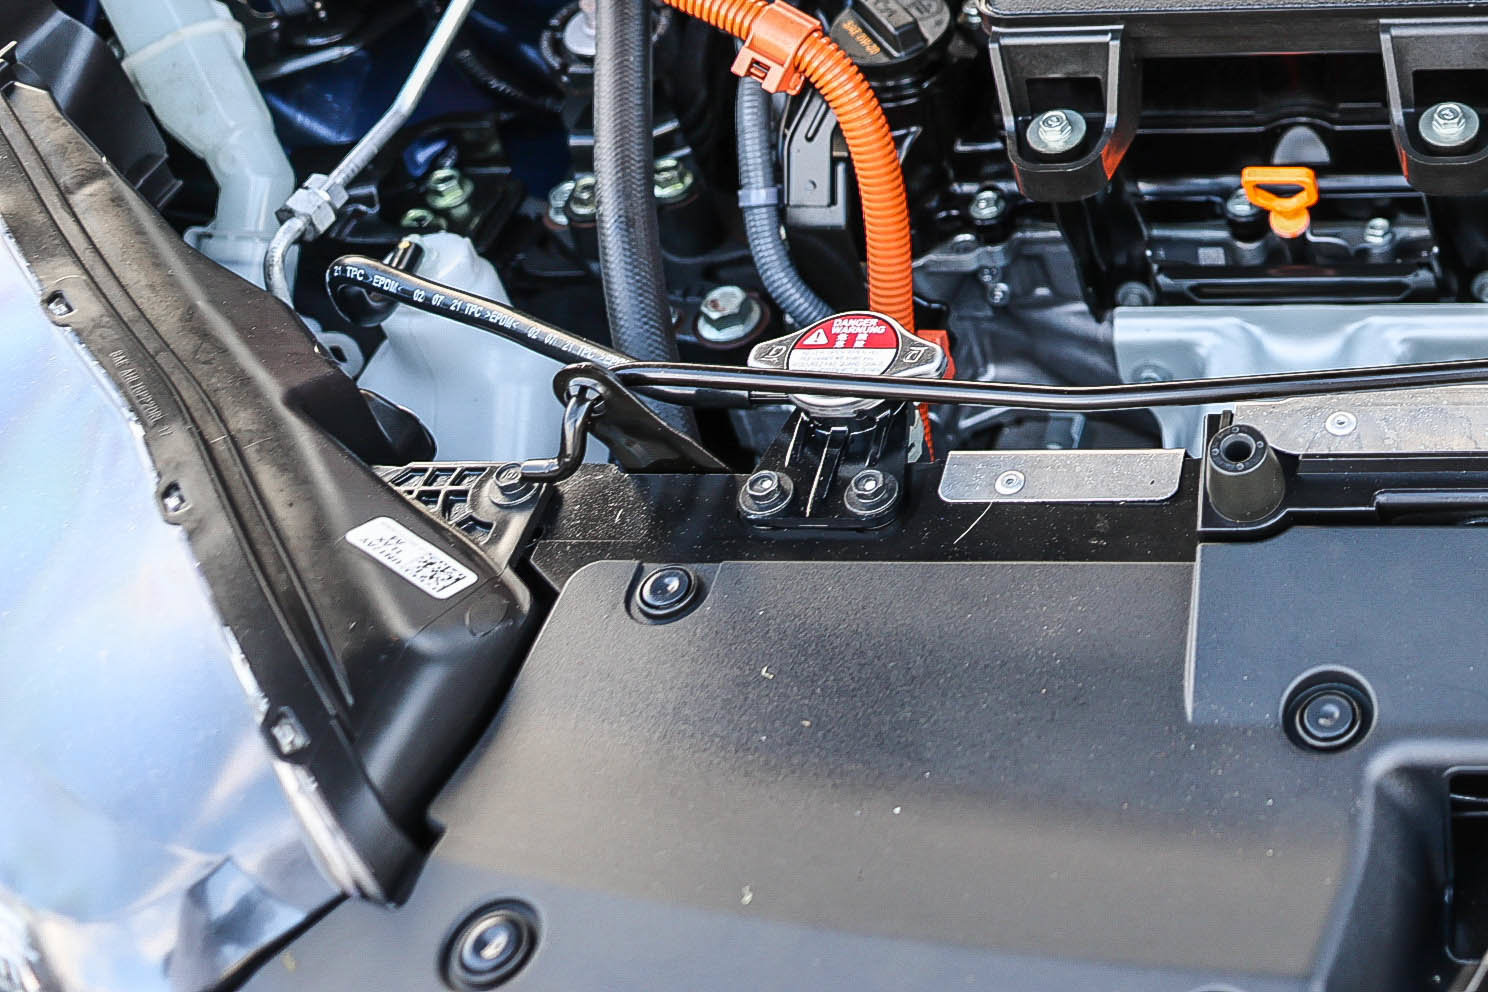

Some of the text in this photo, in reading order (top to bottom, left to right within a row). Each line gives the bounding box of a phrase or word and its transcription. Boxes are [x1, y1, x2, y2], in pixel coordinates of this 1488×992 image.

[346, 266, 364, 281] TPC
[413, 288, 425, 303] 02
[431, 293, 445, 307] 07
[450, 299, 463, 312] 21
[464, 302, 483, 318] TPC
[527, 326, 540, 340] 02
[832, 318, 879, 327] DANGER
[831, 325, 887, 334] WARNUNG
